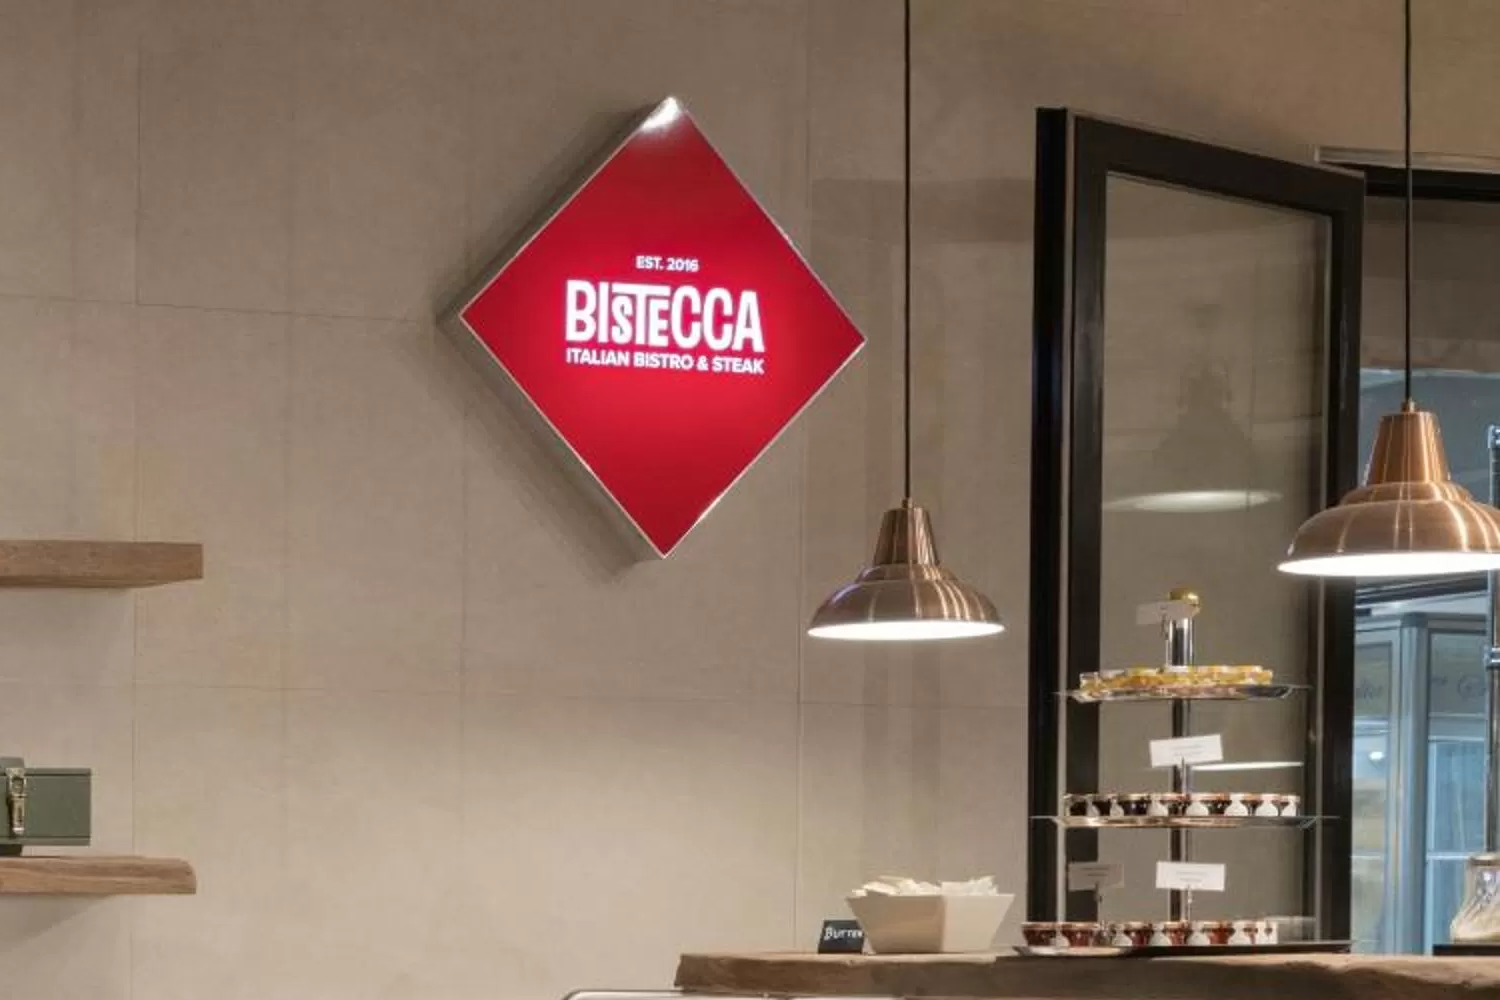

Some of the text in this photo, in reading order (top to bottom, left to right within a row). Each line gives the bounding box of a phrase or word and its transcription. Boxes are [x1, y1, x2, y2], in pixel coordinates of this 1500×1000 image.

[636, 255, 699, 272] EST. 2016
[565, 279, 765, 353] BISTECCA
[566, 347, 765, 374] ITALIAN BISTRO & STEAK
